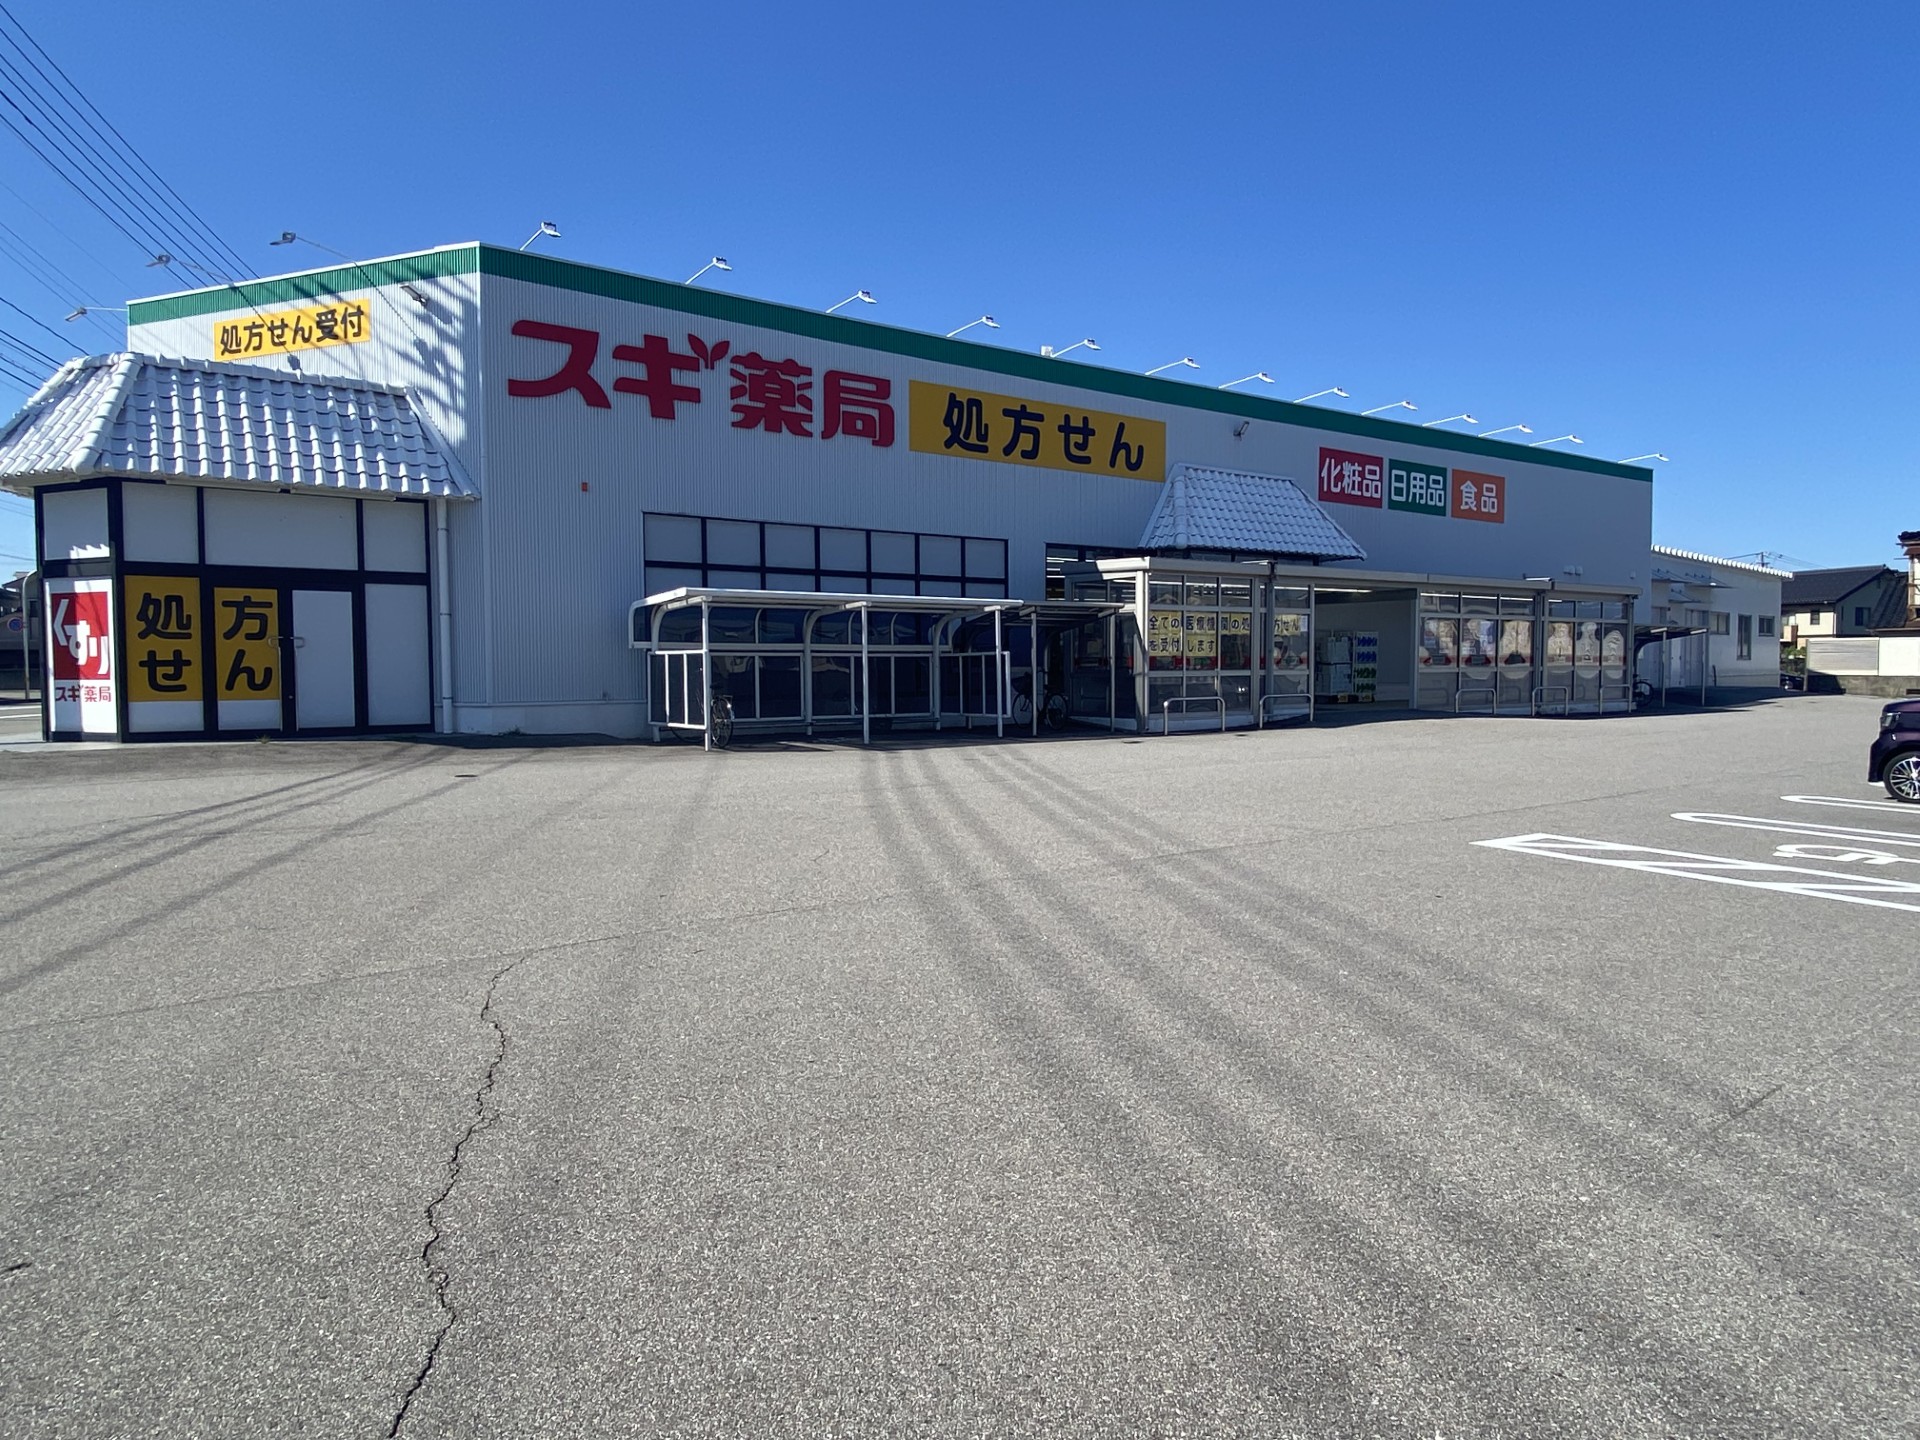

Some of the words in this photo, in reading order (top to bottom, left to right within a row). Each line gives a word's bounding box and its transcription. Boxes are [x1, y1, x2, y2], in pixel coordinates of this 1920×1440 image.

[220, 305, 364, 356] 処方せん受付
[508, 319, 895, 447] スギ薬局
[943, 392, 1144, 472] 処方せん
[1321, 457, 1382, 499] 化粧品
[1391, 469, 1445, 507] 日用品
[1460, 480, 1498, 514] 食品
[53, 598, 110, 675] くすり
[1149, 637, 1216, 653] を受付します
[55, 684, 112, 702] スギ薬局
